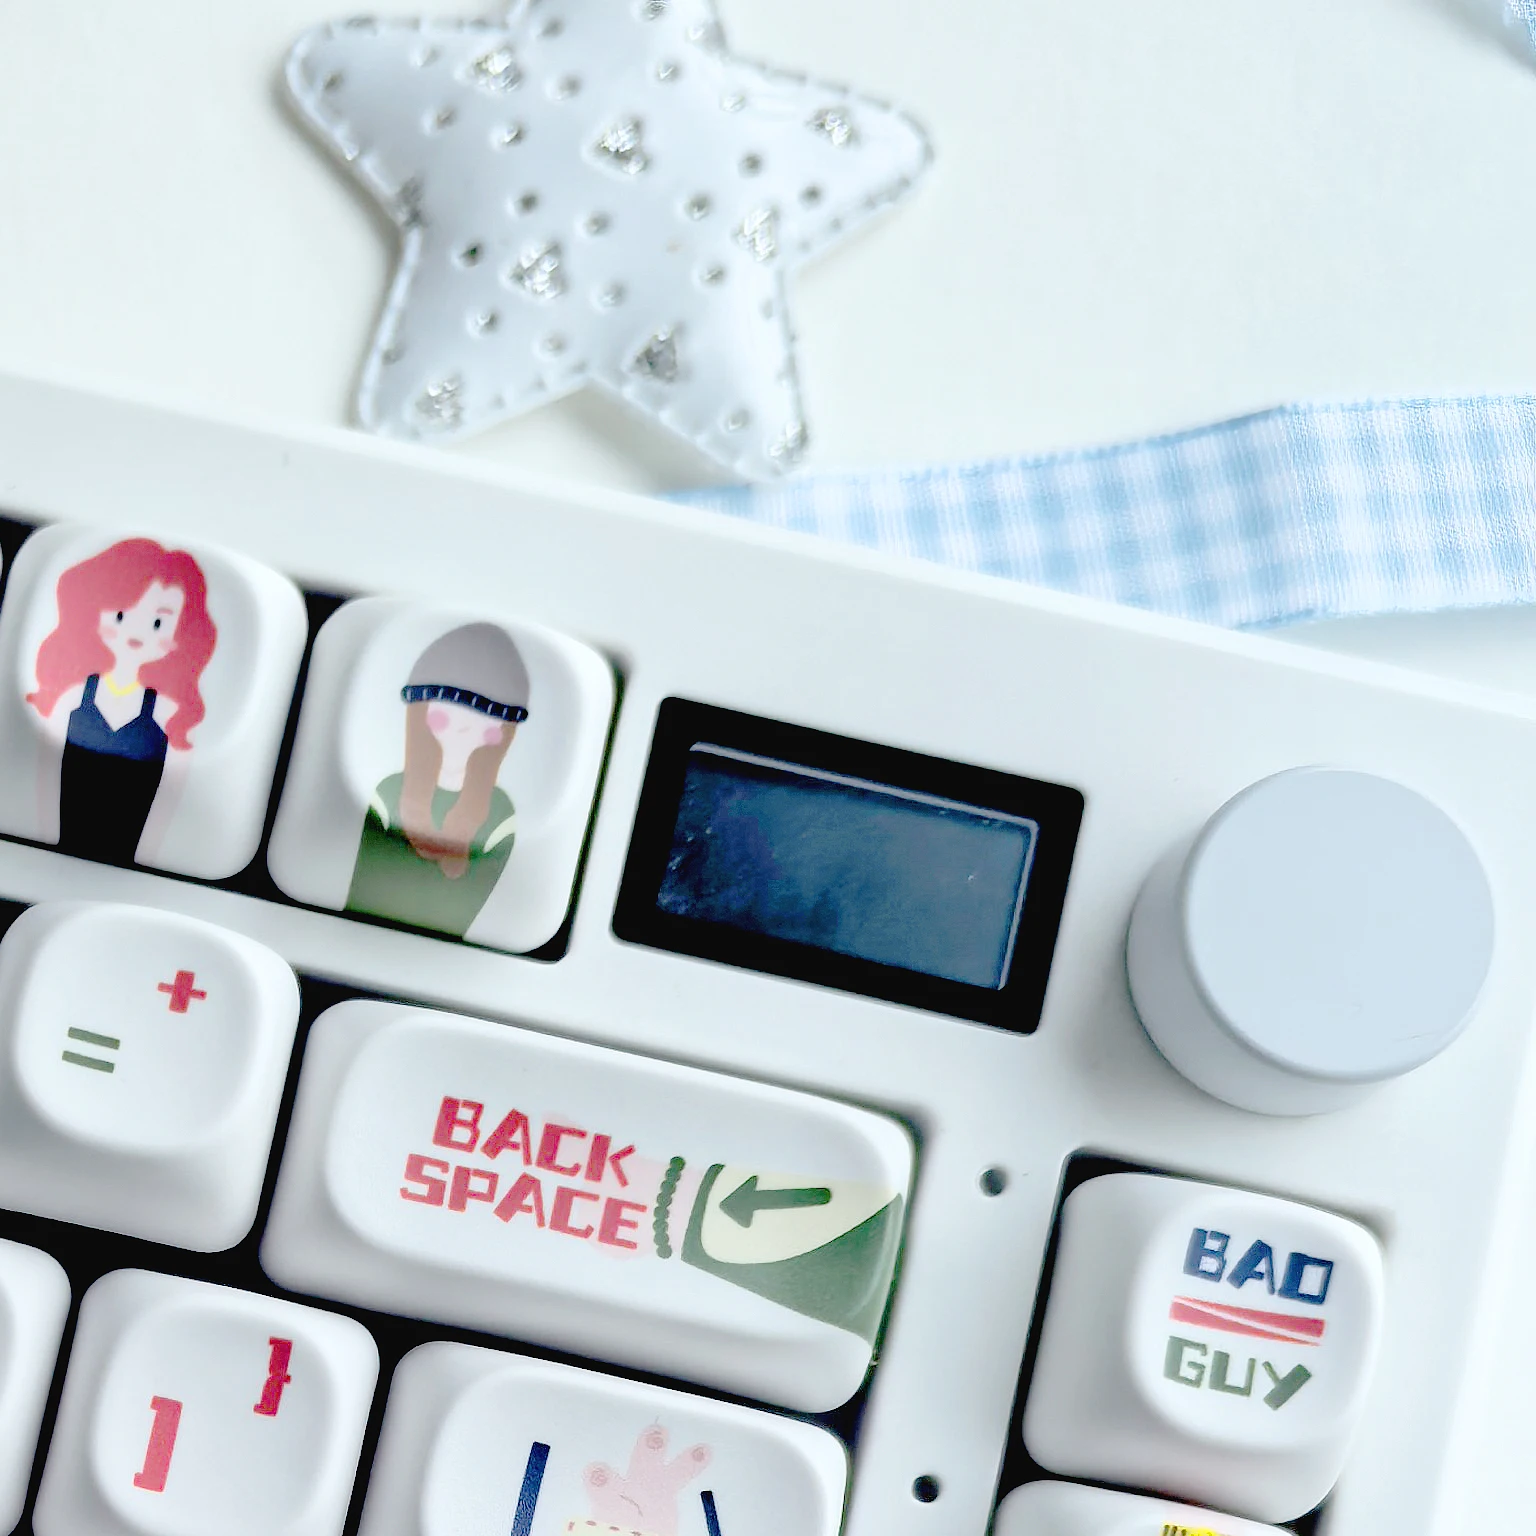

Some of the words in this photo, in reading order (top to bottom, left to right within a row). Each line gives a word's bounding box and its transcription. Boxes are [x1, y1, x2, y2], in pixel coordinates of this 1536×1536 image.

[158, 970, 207, 1013] +
[62, 1027, 120, 1073] =
[432, 1095, 635, 1187] BACK
[399, 1153, 647, 1251] SPACE
[1183, 1227, 1334, 1305] BAD
[1163, 1336, 1312, 1410] GUY
